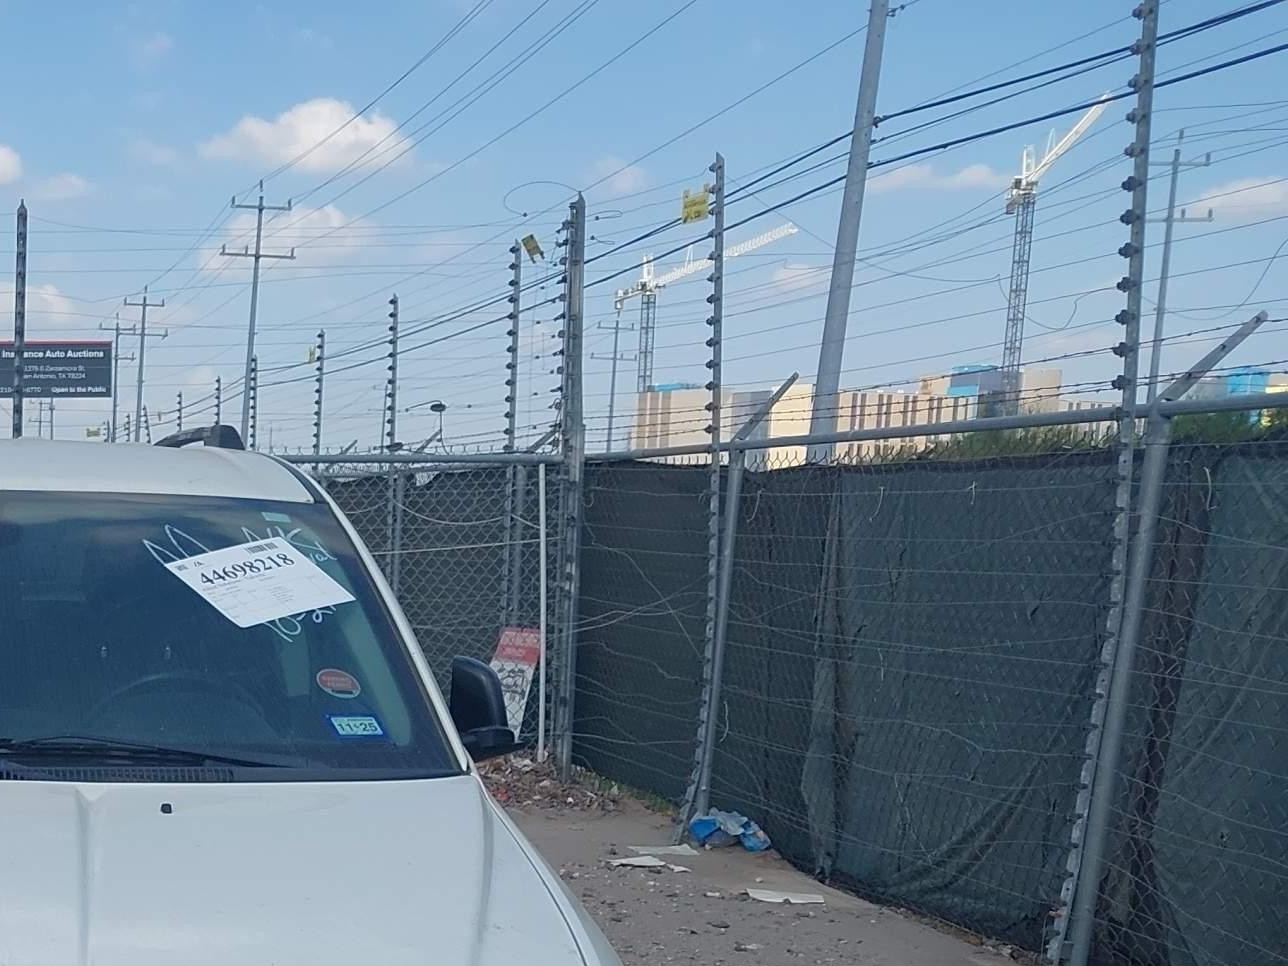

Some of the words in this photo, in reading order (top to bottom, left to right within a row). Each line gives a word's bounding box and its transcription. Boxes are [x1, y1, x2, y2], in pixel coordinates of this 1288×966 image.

[2, 350, 43, 358] Insance
[45, 350, 65, 358] Auto
[67, 350, 104, 358] Auctions
[200, 552, 296, 586] 44698218
